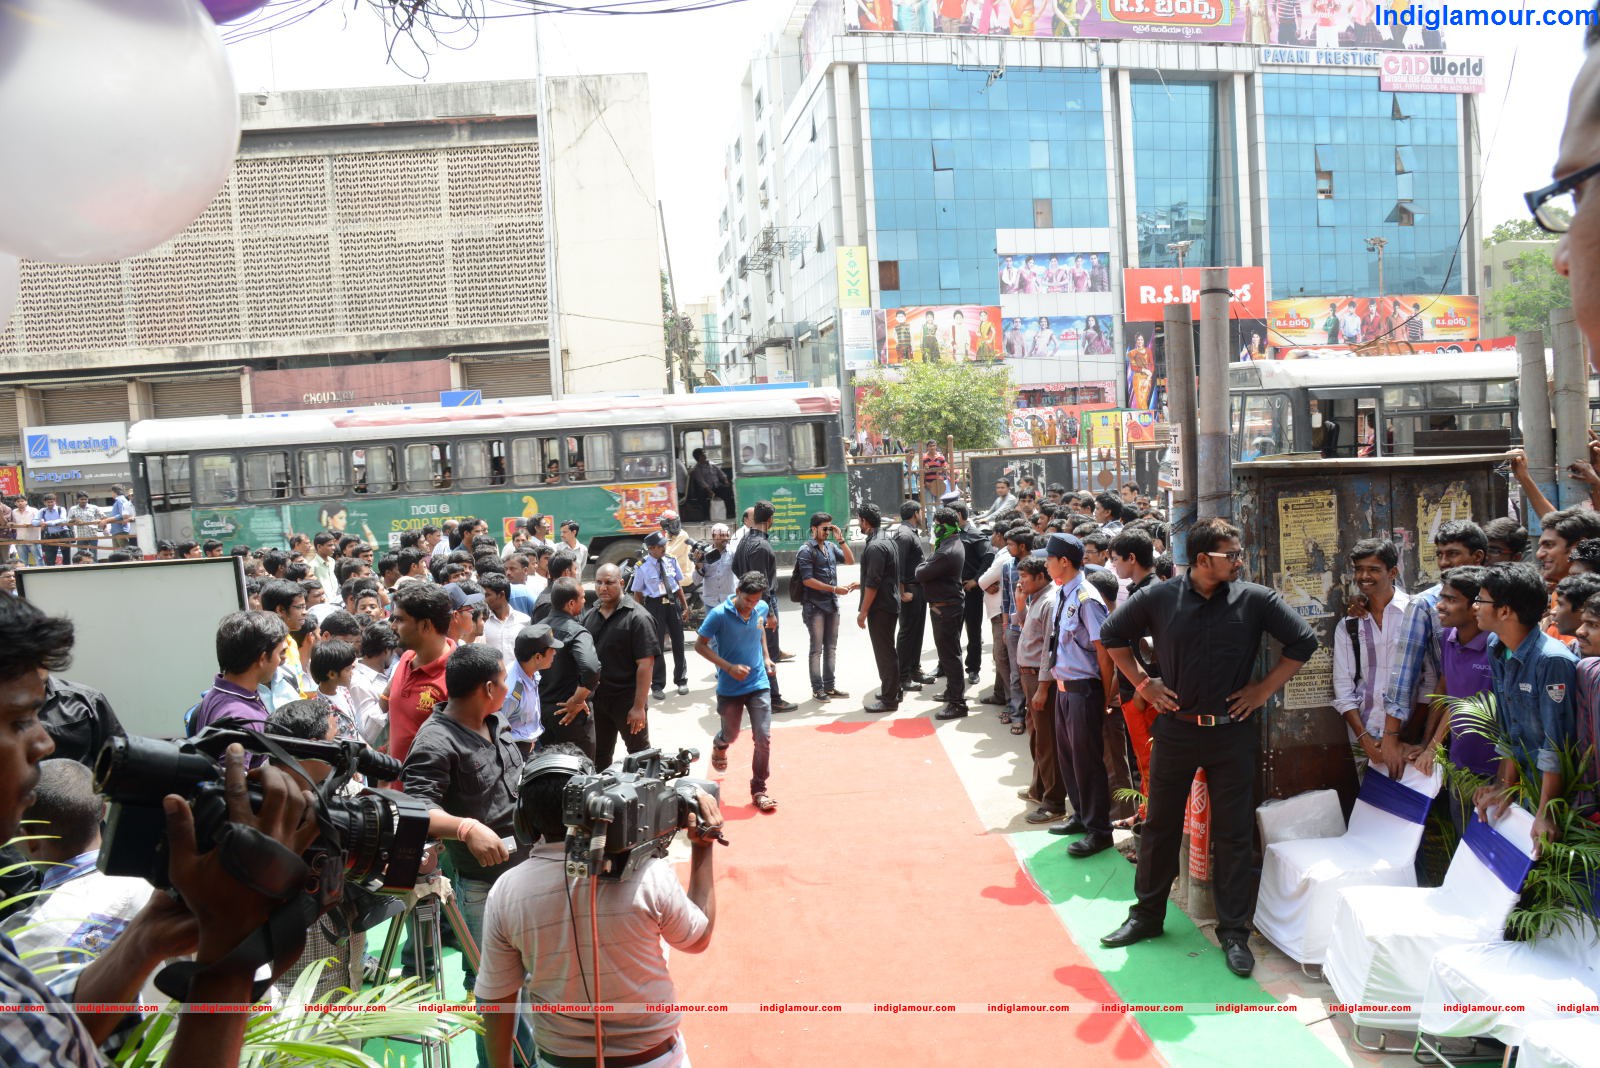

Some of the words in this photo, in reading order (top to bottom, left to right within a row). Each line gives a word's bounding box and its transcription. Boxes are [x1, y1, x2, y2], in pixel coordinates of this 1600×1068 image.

[1263, 49, 1310, 64] PAVANI
[1316, 50, 1379, 66] PRESTIGE
[1383, 56, 1483, 77] CADWorld
[1139, 285, 1181, 305] R.S.
[57, 435, 118, 451] Narsingh
[410, 504, 437, 516] now
